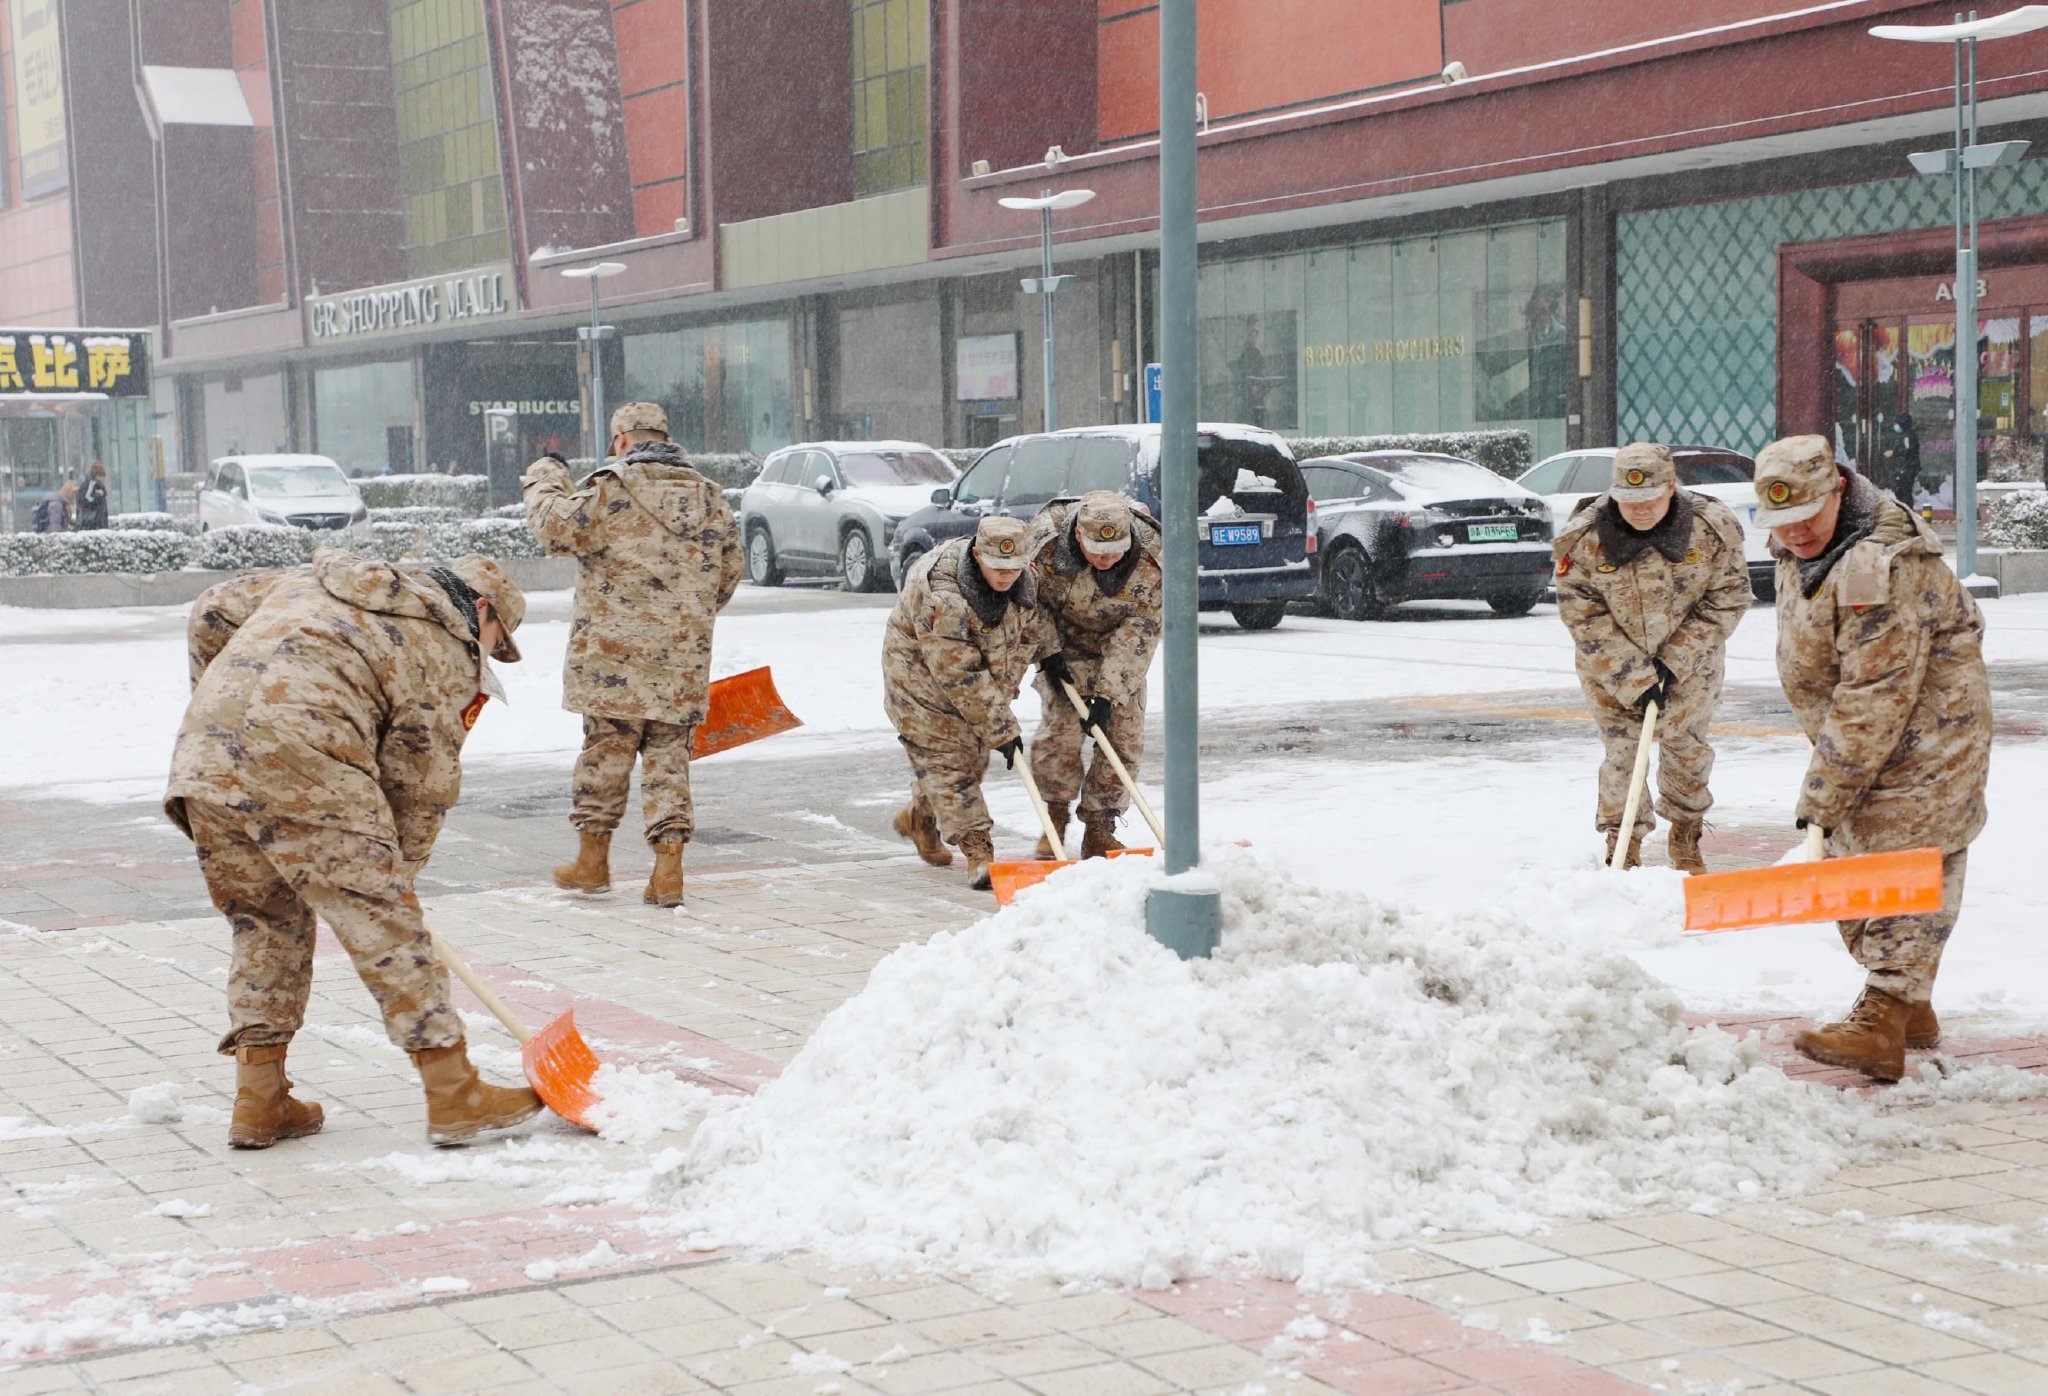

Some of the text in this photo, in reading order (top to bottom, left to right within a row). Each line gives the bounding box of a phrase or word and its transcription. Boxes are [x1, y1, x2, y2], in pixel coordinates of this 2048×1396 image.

[312, 273, 506, 337] GR SHOPPING MALL
[1305, 335, 1465, 368] BROOKS BROTHERS
[469, 400, 580, 415] STARBUCKS
[491, 416, 509, 441] P
